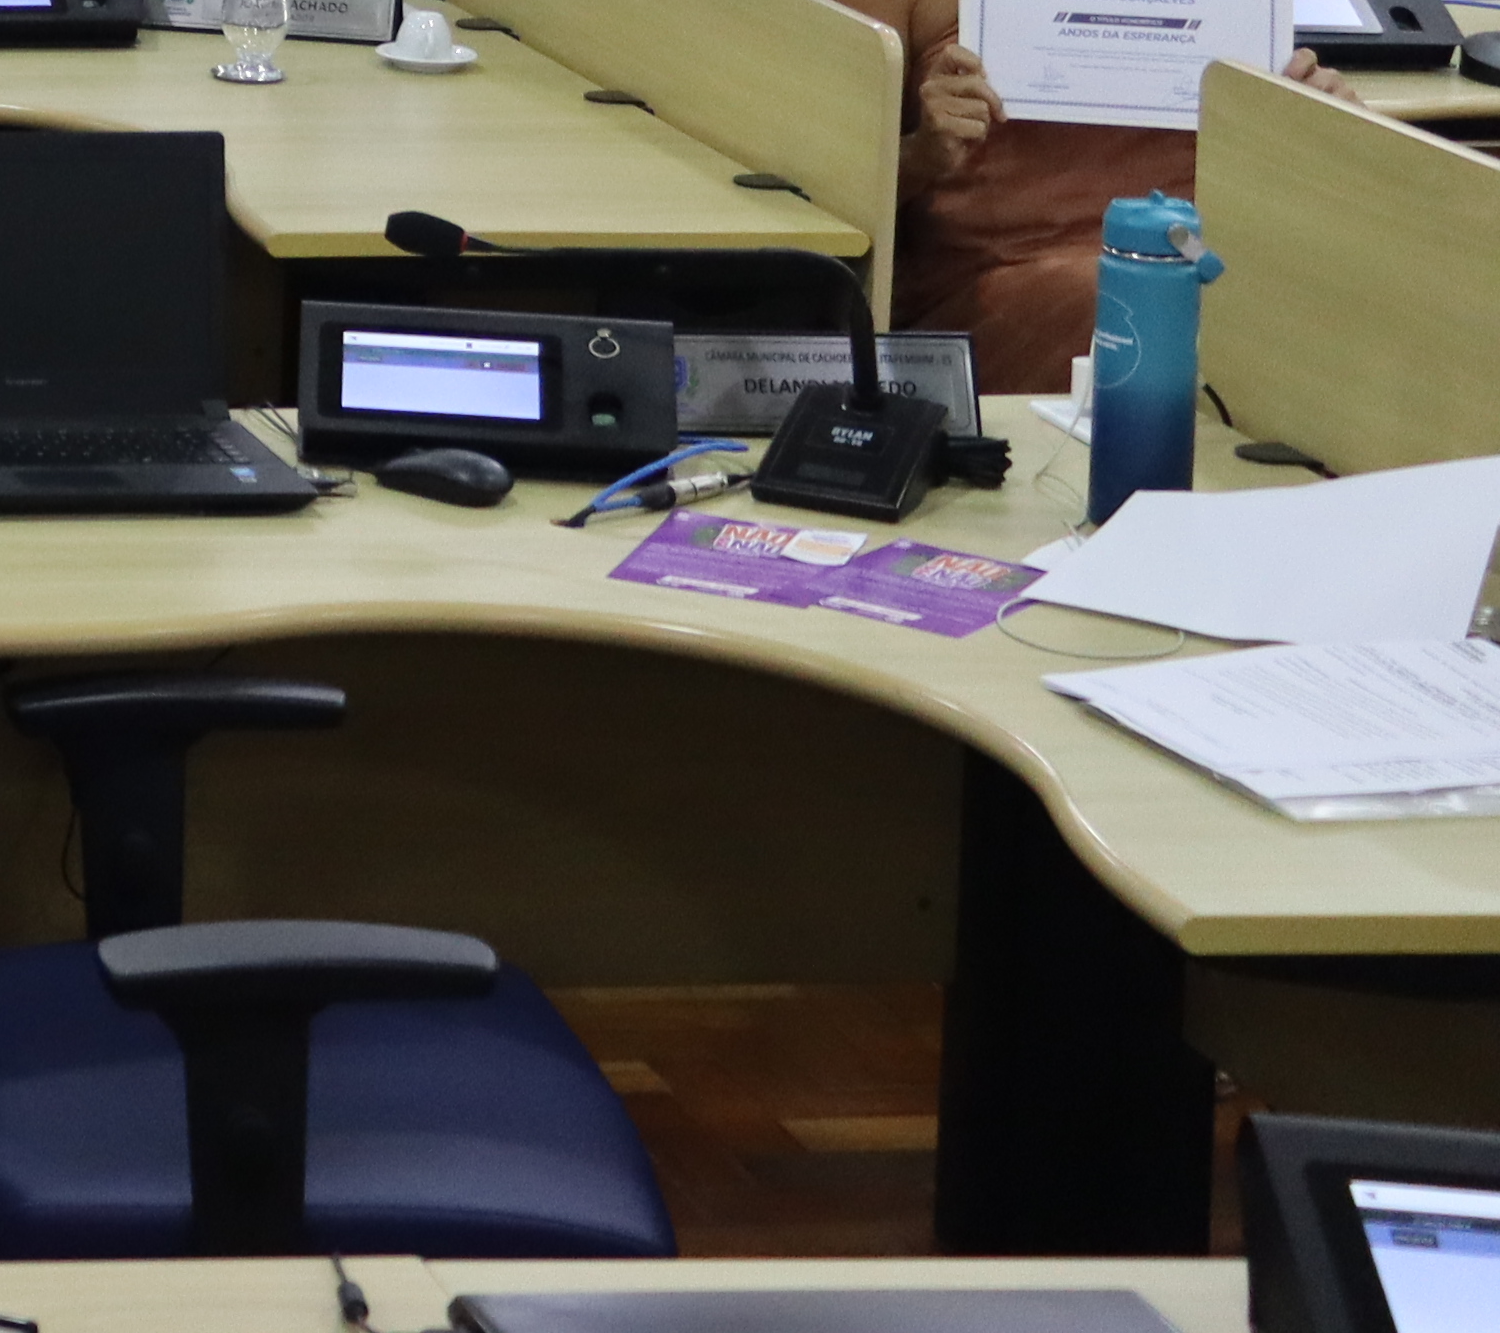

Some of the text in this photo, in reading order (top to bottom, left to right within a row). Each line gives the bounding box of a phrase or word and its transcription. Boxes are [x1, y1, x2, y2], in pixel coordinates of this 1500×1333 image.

[291, 0, 348, 13] ACHADO
[1058, 28, 1196, 43] ANJOS DA ESPERANÇA
